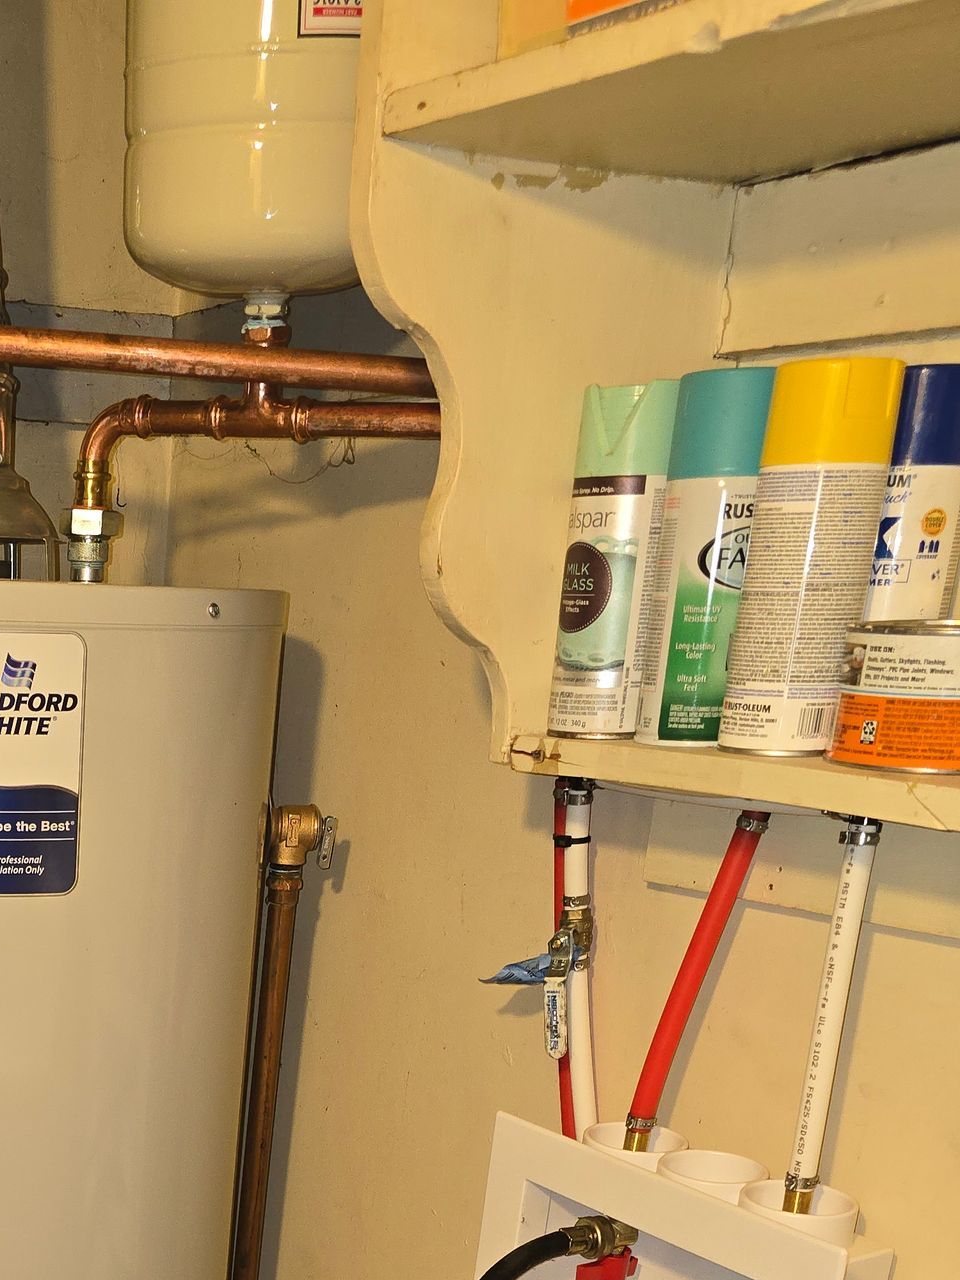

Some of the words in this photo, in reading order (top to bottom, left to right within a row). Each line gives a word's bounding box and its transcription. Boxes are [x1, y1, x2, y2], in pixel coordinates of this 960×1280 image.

[567, 563, 590, 575] MILK
[683, 605, 709, 613] Ultimate
[683, 614, 718, 622] Resistance
[675, 642, 716, 652] Long-Lasting
[685, 651, 703, 659] Color
[677, 675, 693, 683] Ultra
[693, 674, 707, 683] Soft
[684, 683, 698, 692] Feel
[724, 701, 771, 713] RUST-OLEUM
[16, 820, 37, 832] the
[25, 866, 45, 876] Only
[838, 881, 850, 910] ASTM
[834, 915, 844, 937] E84
[809, 1041, 822, 1081] S102.2
